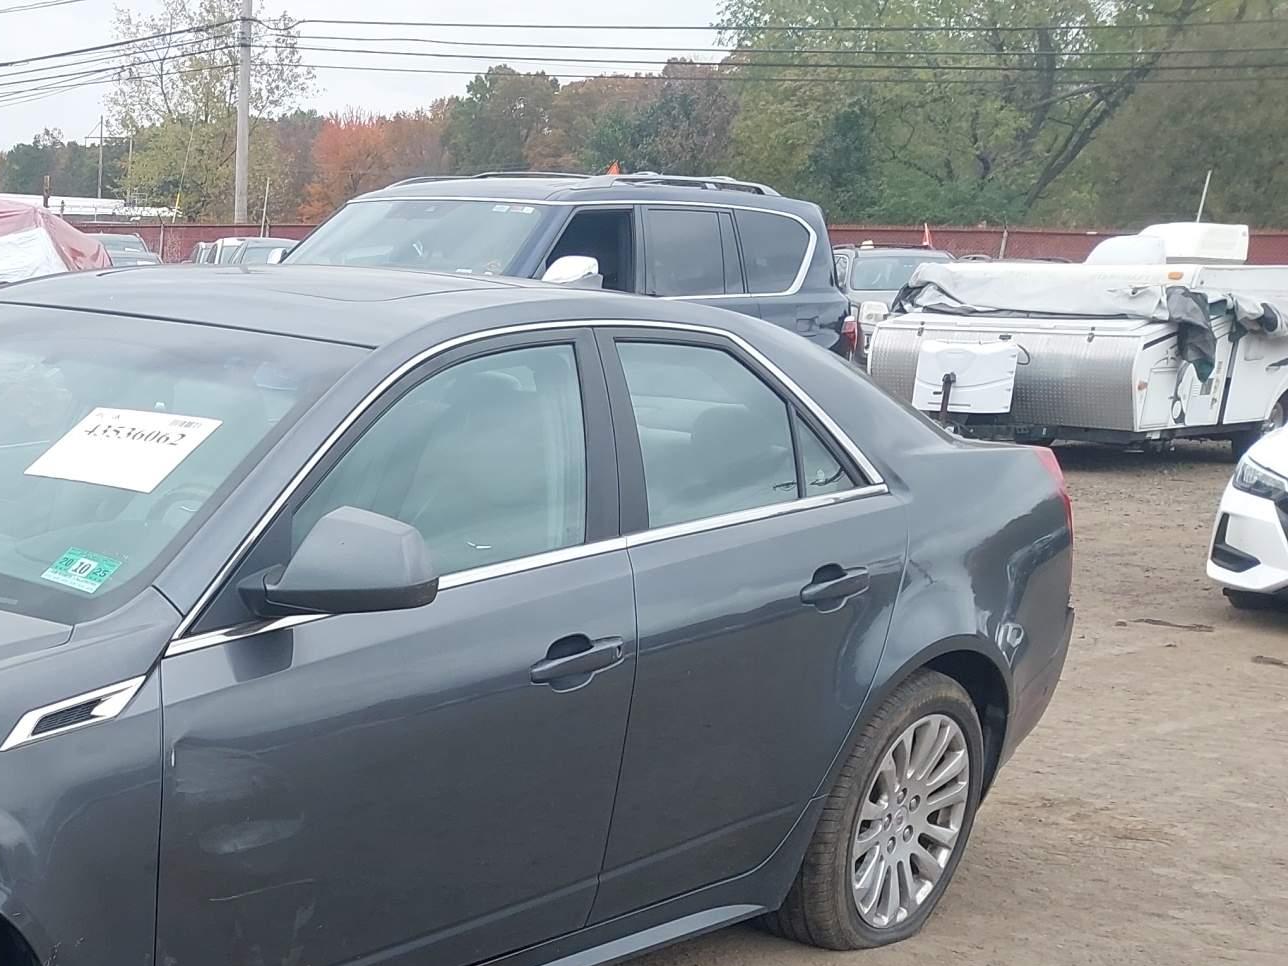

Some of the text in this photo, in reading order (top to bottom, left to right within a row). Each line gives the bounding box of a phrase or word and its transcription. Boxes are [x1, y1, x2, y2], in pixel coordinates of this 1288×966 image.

[84, 424, 187, 446] 43536062
[59, 557, 74, 567] 20
[72, 561, 92, 575] 10
[92, 567, 109, 578] 25
